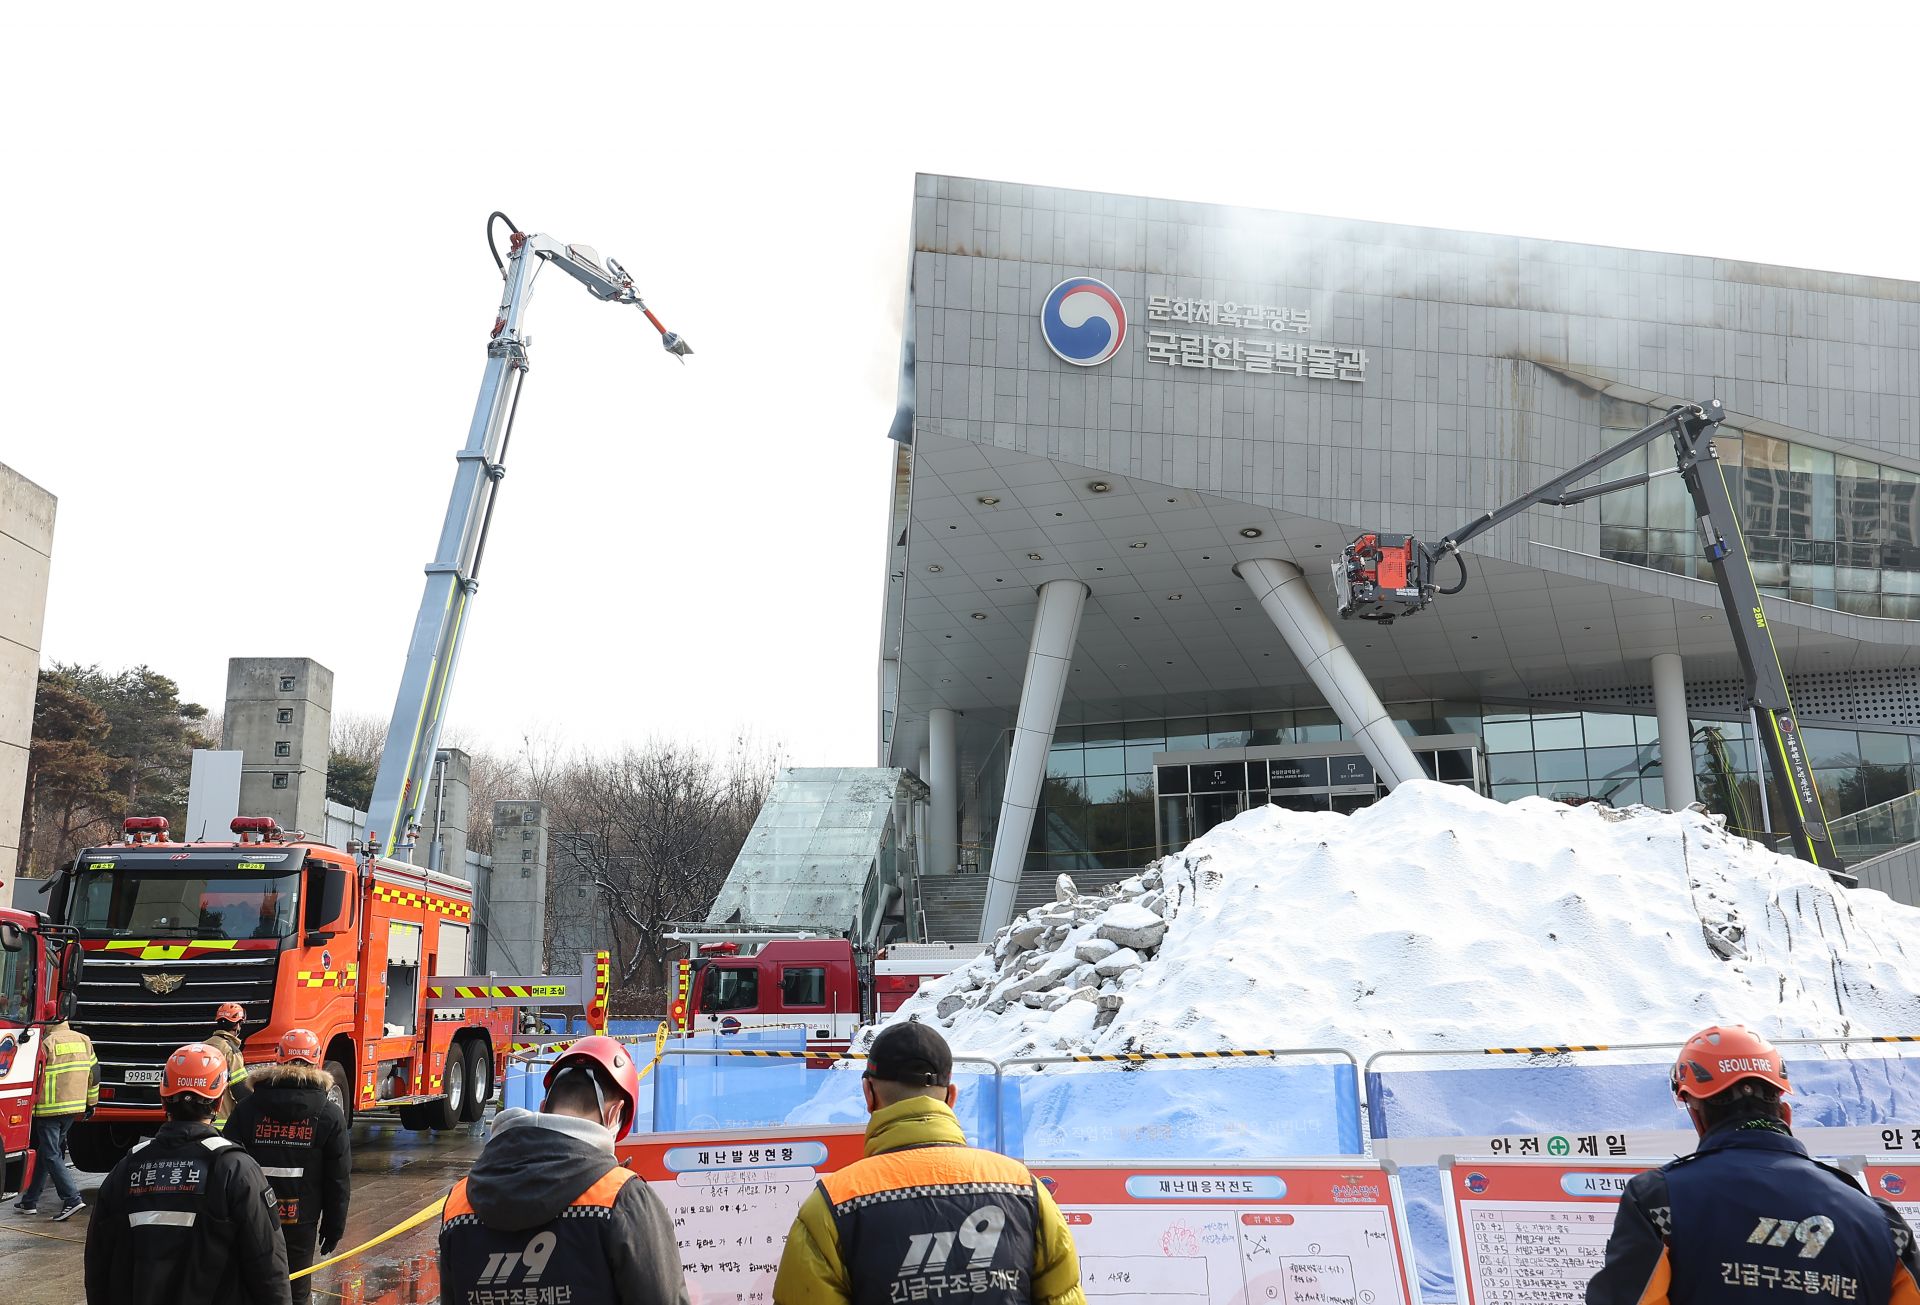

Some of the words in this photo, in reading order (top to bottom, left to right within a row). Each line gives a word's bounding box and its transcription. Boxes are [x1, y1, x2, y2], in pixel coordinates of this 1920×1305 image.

[1148, 294, 1312, 333] 문화체육관광부
[1147, 330, 1370, 382] 국립한글박물관
[1752, 606, 1765, 628] 28M
[532, 987, 546, 996] 머리
[549, 986, 565, 996] 조심
[301, 1048, 310, 1056] FIRE
[1718, 1059, 1751, 1073] SEOUL
[1751, 1058, 1773, 1073] FIRE
[193, 1078, 207, 1087] FIRE
[255, 1124, 313, 1140] 긴급구조통제단
[1490, 1137, 1540, 1156] 안전
[1577, 1134, 1628, 1157] 제일
[697, 1148, 794, 1165] 재난발생현황
[148, 1185, 177, 1193] Relations
[178, 1184, 197, 1192] Staff
[1159, 1179, 1254, 1193] 재난대응작전도
[1550, 1214, 1595, 1222] 조치사항
[898, 1205, 1006, 1277] 119
[1746, 1215, 1835, 1260] 119
[477, 1230, 558, 1286] 119
[890, 1268, 1020, 1304] 긴급구조통제단
[1720, 1261, 1858, 1300] 긴급구조통제단
[466, 1285, 572, 1305] 긴급구조통제단
